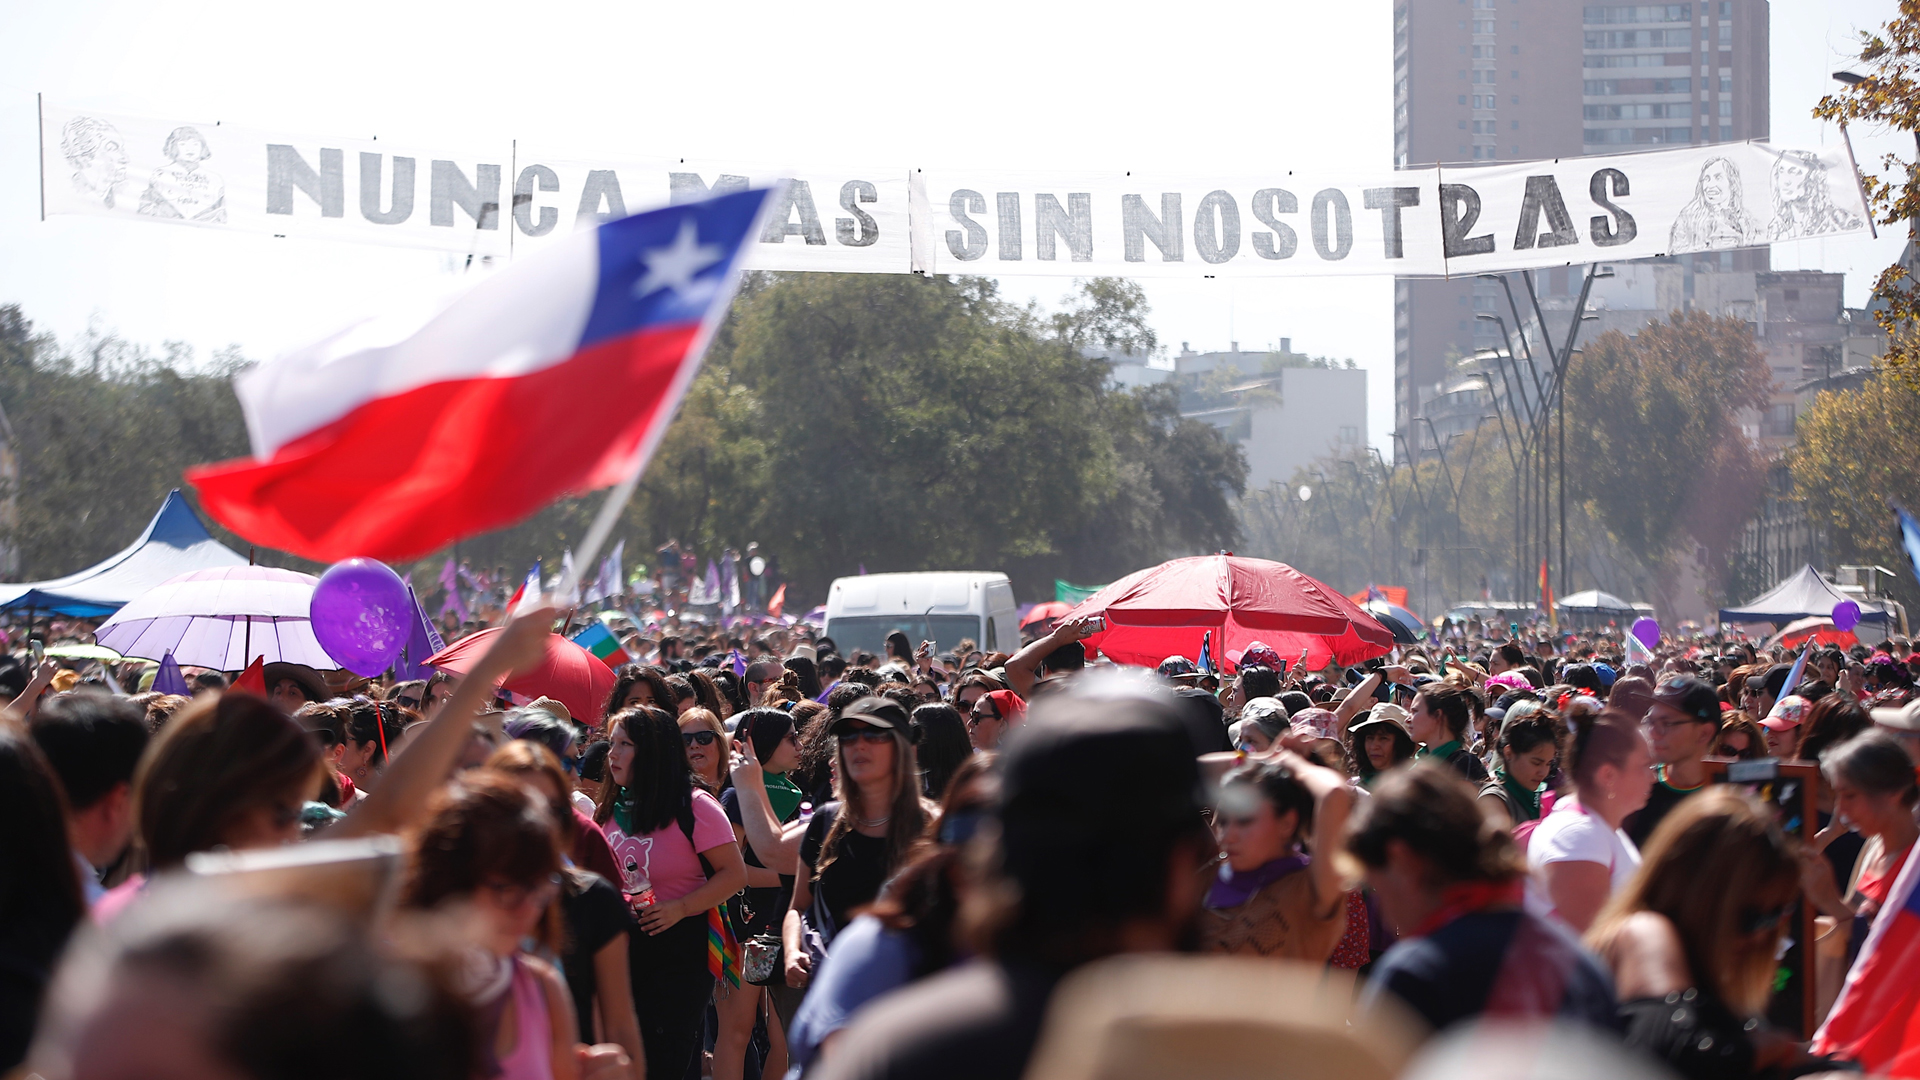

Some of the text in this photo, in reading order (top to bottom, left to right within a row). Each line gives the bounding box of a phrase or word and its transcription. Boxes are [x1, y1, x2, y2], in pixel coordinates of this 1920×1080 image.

[265, 143, 628, 237] NUNCA
[945, 188, 1093, 262] SIN
[1122, 167, 1638, 263] NOSOTRAS
